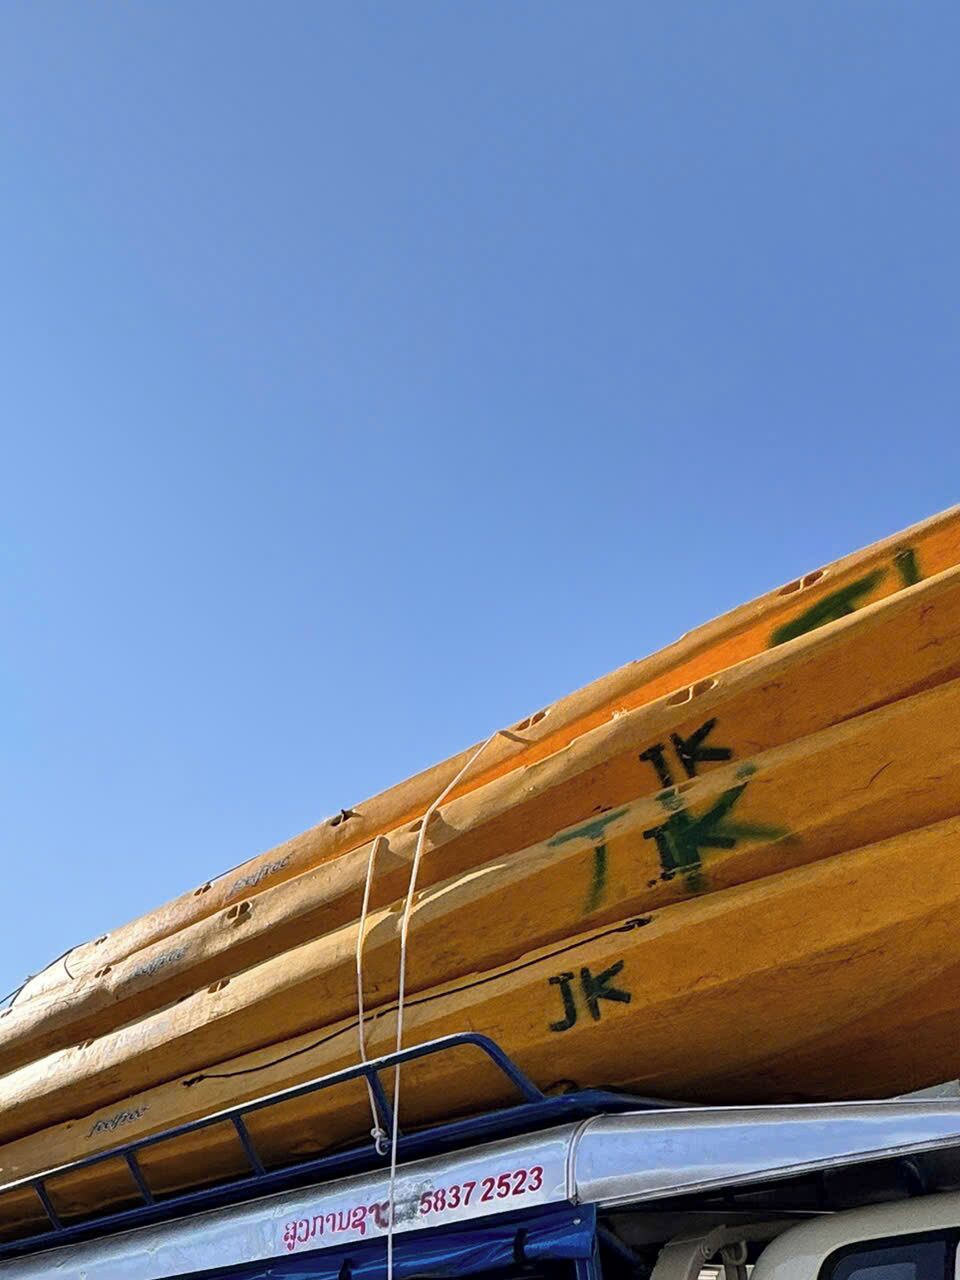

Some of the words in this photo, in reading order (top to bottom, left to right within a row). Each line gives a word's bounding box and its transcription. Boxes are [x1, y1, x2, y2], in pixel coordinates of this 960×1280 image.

[548, 959, 632, 1033] JK
[420, 1182, 477, 1214] 5837
[480, 1166, 543, 1202] 2523
